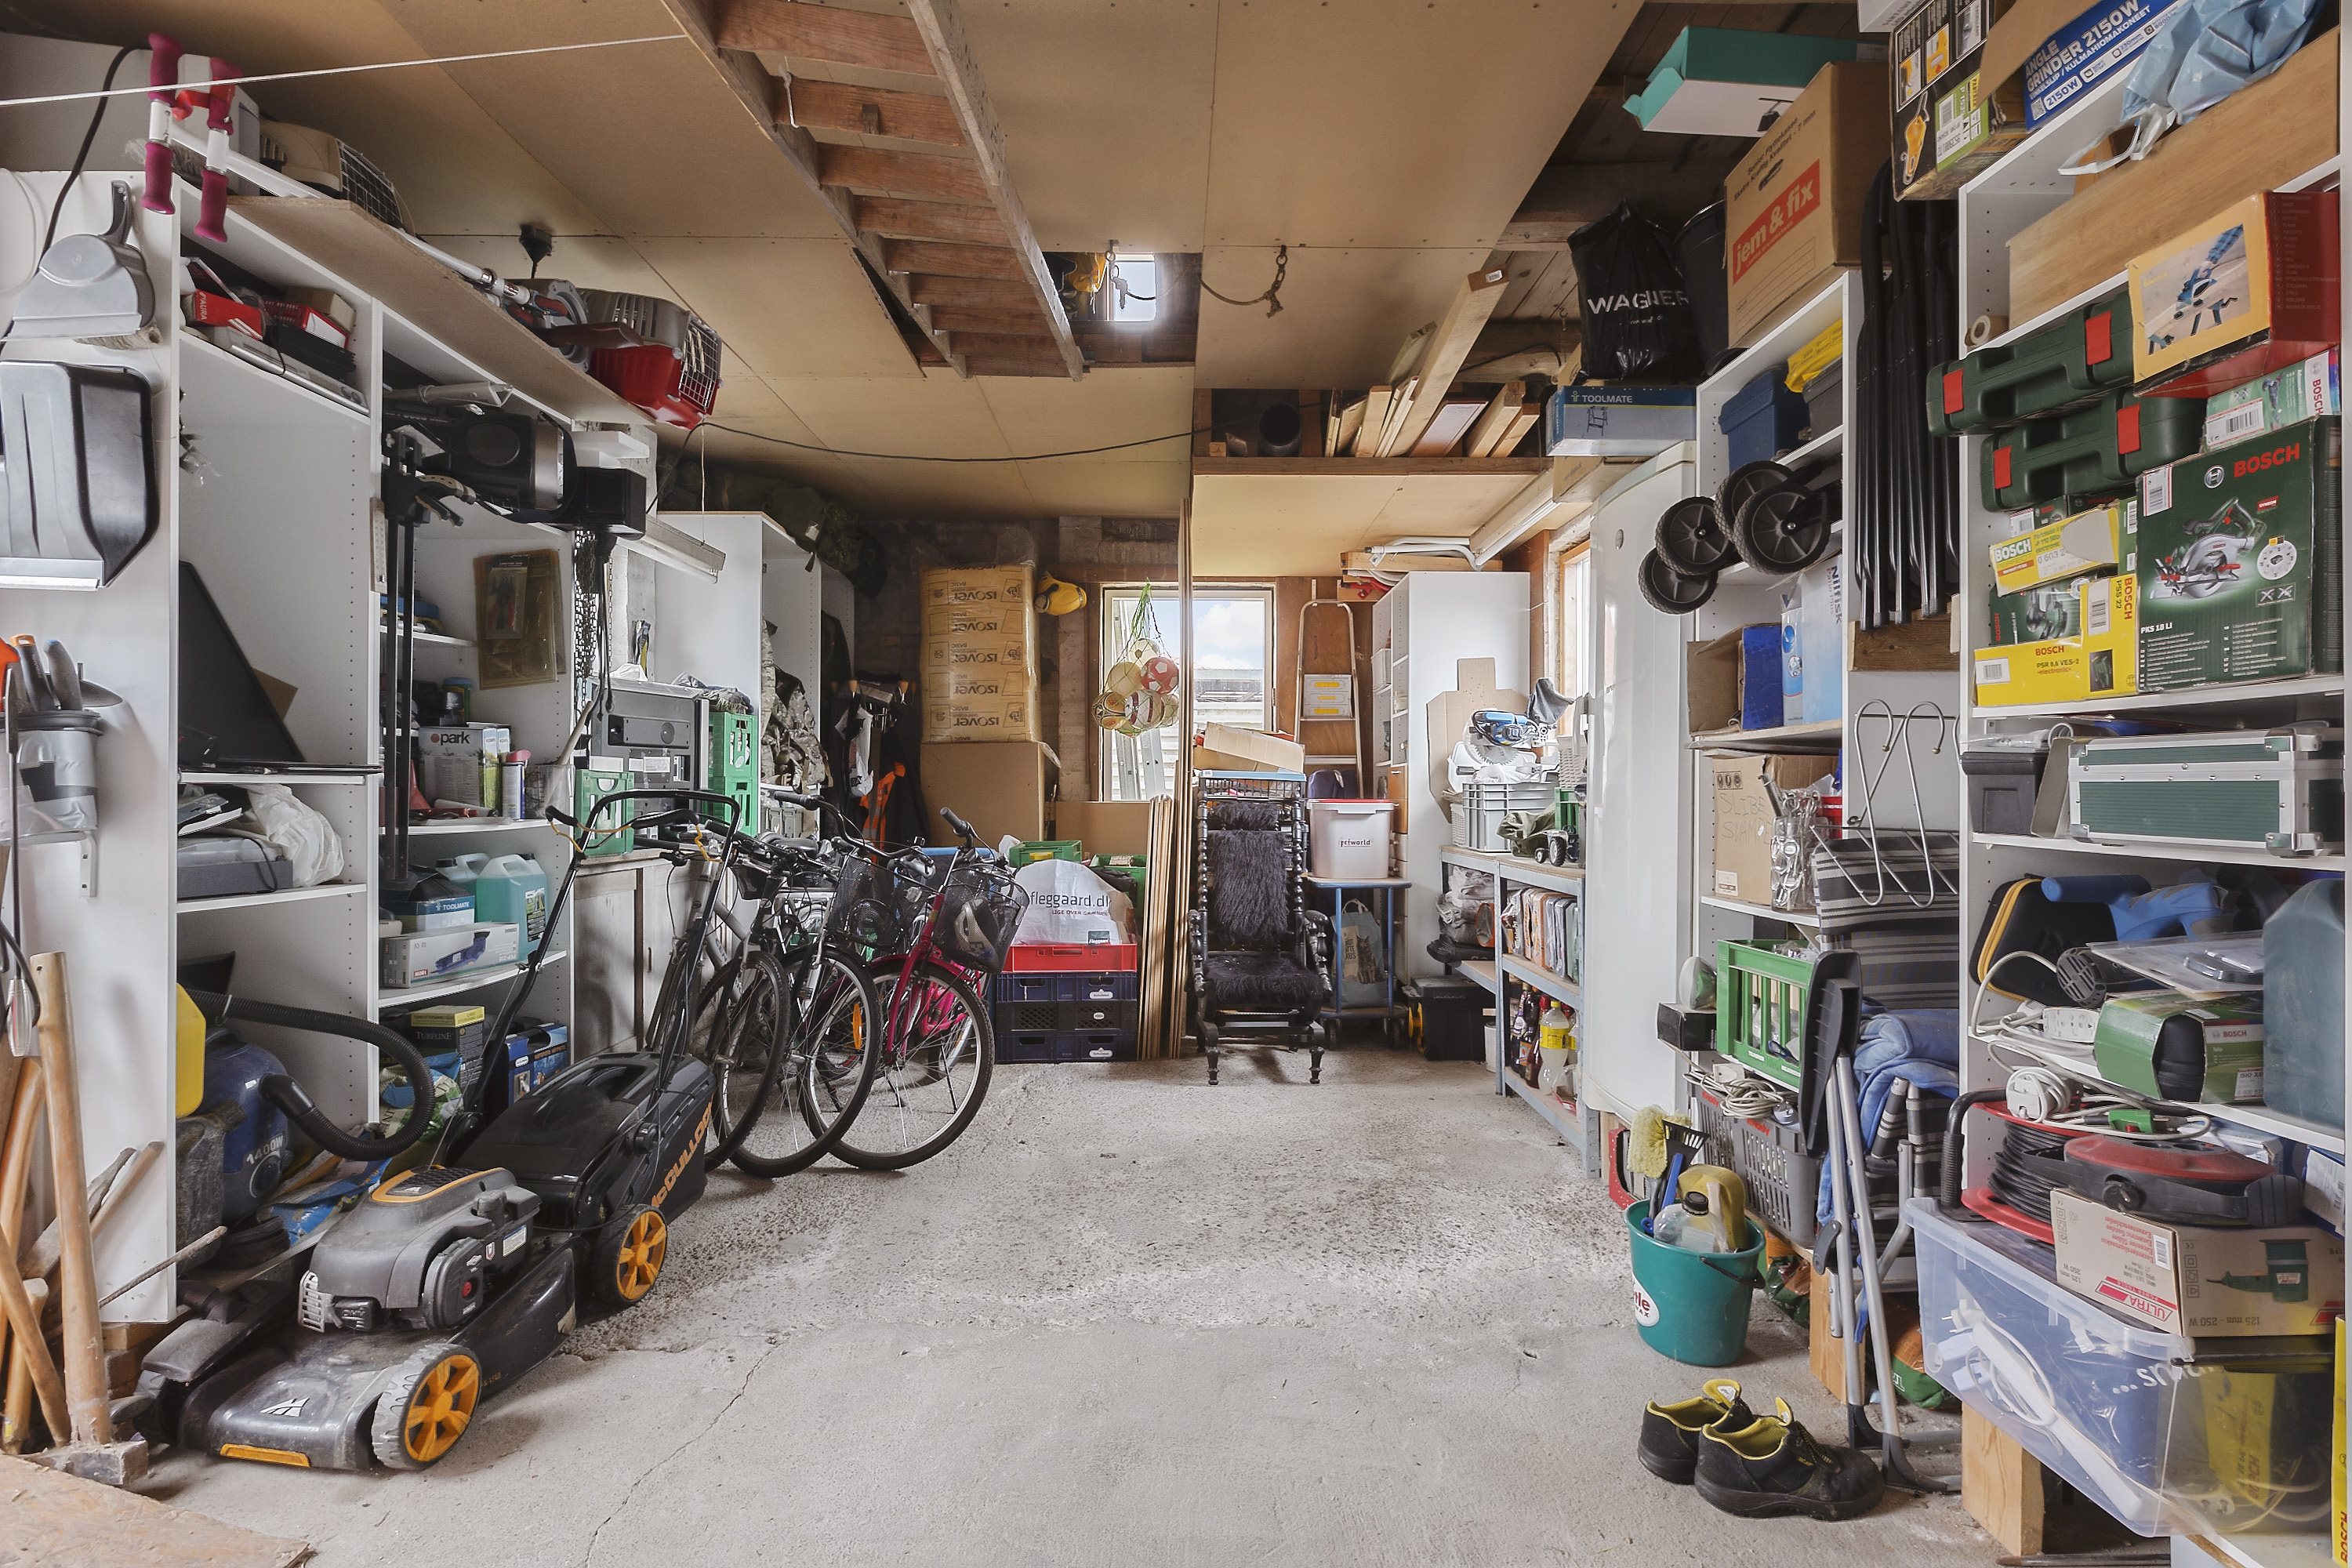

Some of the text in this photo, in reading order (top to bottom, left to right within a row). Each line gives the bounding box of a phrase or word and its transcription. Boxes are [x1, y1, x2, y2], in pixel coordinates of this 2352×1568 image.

[2027, 41, 2084, 92] GRINDER
[2082, 0, 2139, 48] 2150W
[2066, 5, 2151, 72] KULMAHIOMAKONEET
[2026, 40, 2060, 77] ANGLE
[2047, 78, 2078, 107] 2150W
[1736, 225, 1766, 274] jem
[1769, 205, 1784, 234] &
[1787, 179, 1814, 219] fix
[1588, 290, 1689, 314] WAGNER
[1582, 394, 1632, 403] TOOLMATE
[2313, 379, 2324, 415] BOSCH
[2234, 443, 2300, 477] BOSCH
[1994, 539, 2032, 563] BOSCH
[1831, 565, 1842, 625] Nilfisk
[2035, 645, 2064, 655] BOSCH
[440, 731, 470, 746] park
[1719, 793, 1769, 816] SLIBE
[1341, 838, 1370, 848] petworld
[442, 902, 470, 910] TOOLMATE
[416, 1032, 453, 1040] TURFLINE
[246, 1136, 283, 1164] 1400W
[2071, 1274, 2082, 1284] 125
[1635, 1292, 1650, 1311] tle
[2129, 1295, 2165, 1319] ULTRA
[2189, 1318, 2199, 1327] W
[2201, 1317, 2218, 1326] 250
